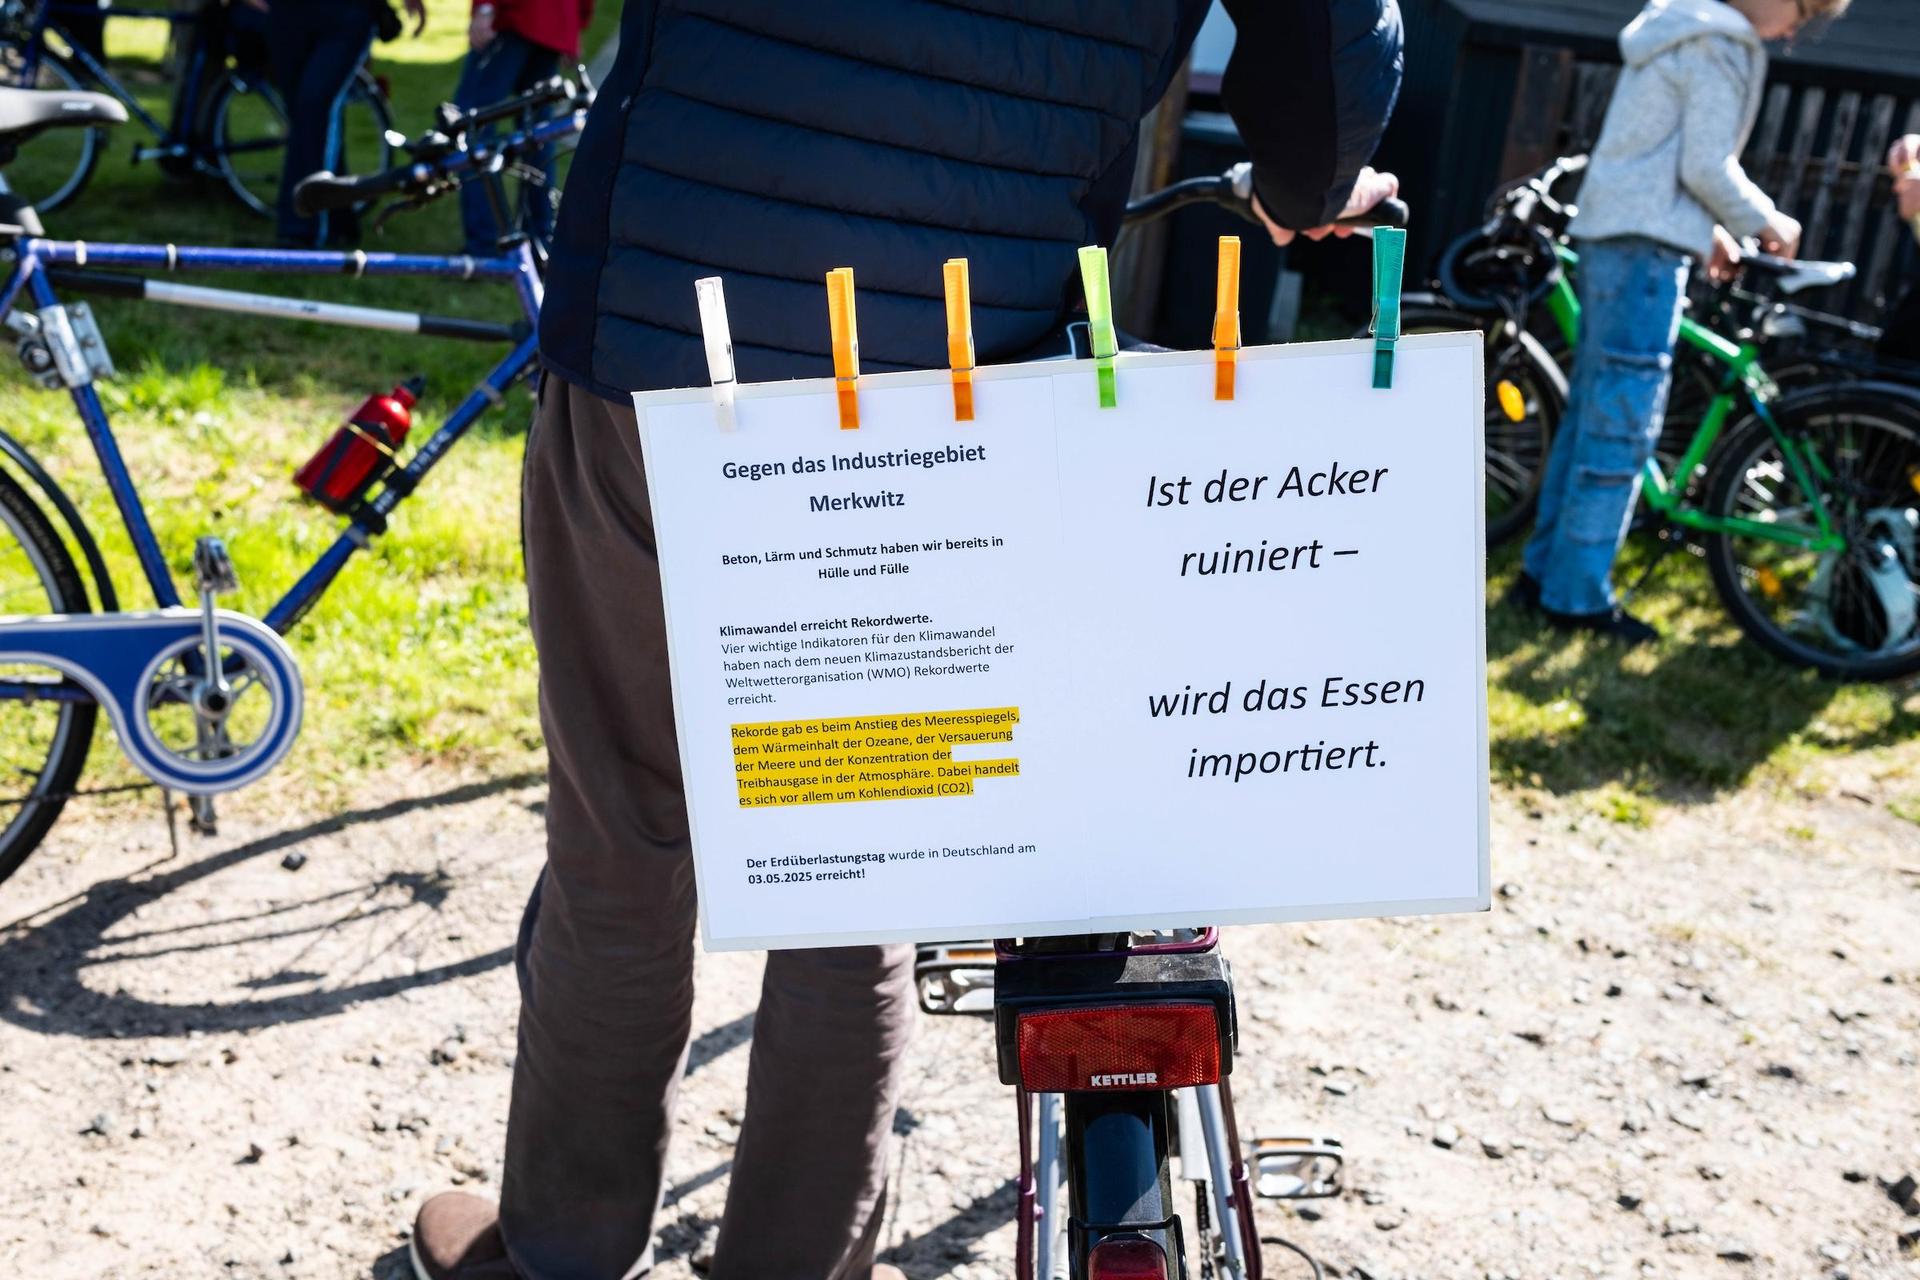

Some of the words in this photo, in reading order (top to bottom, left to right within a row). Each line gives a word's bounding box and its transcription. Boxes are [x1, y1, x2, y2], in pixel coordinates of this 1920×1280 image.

[722, 462, 786, 481] Gegen
[792, 456, 826, 474] das
[832, 444, 986, 471] Industriegebiet
[1147, 476, 1192, 507] Ist
[1204, 469, 1268, 503] der
[1276, 461, 1389, 499] Acker
[809, 490, 905, 512] Merkwitz
[722, 554, 762, 566] Beton,
[765, 550, 795, 563] Lärm
[799, 547, 822, 561] und
[825, 545, 877, 559] Schmutz
[880, 541, 919, 555] haben
[922, 539, 942, 552] wir
[945, 536, 989, 551] bereits
[991, 535, 1003, 548] in
[1181, 540, 1323, 577] ruiniert
[818, 566, 850, 580] Hülle
[853, 563, 877, 578] und
[880, 562, 909, 576] Fülle
[719, 620, 797, 638] Klimawandel
[801, 617, 848, 632] erreicht
[851, 613, 933, 629] Rekordwerte.
[721, 642, 745, 655] Vier
[748, 639, 797, 654] wichtige
[801, 636, 868, 650] Indikatoren
[871, 632, 890, 645] für
[893, 631, 915, 644] den
[919, 625, 995, 642] Klimawandel
[723, 659, 760, 672] haben
[764, 656, 791, 670] nach
[795, 655, 821, 668] dem
[824, 654, 861, 666] neuen
[865, 643, 991, 663] Klimazustandsbericht
[994, 642, 1014, 655] der
[725, 669, 863, 689] Weltwetterorganisation
[867, 665, 910, 682] (WMO)
[914, 662, 990, 677] Rekordwerte
[728, 692, 776, 706] erreicht.
[1149, 681, 1231, 718] wird
[1243, 679, 1308, 712] das
[1321, 677, 1424, 708] Essen
[731, 724, 778, 739] Rekorde
[782, 723, 802, 738] gab
[806, 724, 818, 735] es
[822, 721, 851, 733] beim
[855, 718, 898, 731] Anstieg
[901, 716, 921, 728] des
[925, 710, 1019, 727] Meeresspiegels,
[733, 744, 759, 756] dem
[762, 738, 839, 754] Wärmeinhalt
[843, 737, 862, 749] der
[866, 736, 912, 748] Ozeane,
[916, 733, 935, 745] der
[938, 730, 1013, 743] Versauerung
[735, 761, 754, 773] der
[758, 759, 796, 771] Meere
[799, 756, 821, 769] und
[825, 755, 844, 767] der
[848, 751, 929, 766] Konzentration
[932, 749, 952, 761] der
[1188, 740, 1386, 783] importiert.
[736, 776, 818, 789] Treibhausgase
[822, 773, 832, 785] in
[836, 772, 855, 784] der
[859, 768, 934, 782] Atmosphäre.
[938, 765, 971, 778] Dabei
[975, 762, 1019, 776] handelt
[739, 796, 752, 806] es
[755, 793, 777, 805] sich
[780, 794, 798, 804] vor
[802, 790, 833, 803] allem
[837, 790, 855, 801] um
[859, 783, 934, 799] Kohlendioxid
[938, 781, 974, 797] (CO2).
[746, 857, 767, 869] Der
[770, 852, 886, 868] Erdüberlastungstag
[888, 848, 925, 861] wurde
[928, 847, 939, 859] in
[942, 842, 1014, 859] Deutschland
[1018, 844, 1036, 854] am
[748, 870, 812, 885] 03.05.2025
[815, 867, 865, 882] erreicht!
[1090, 1072, 1158, 1087] KETTLER
